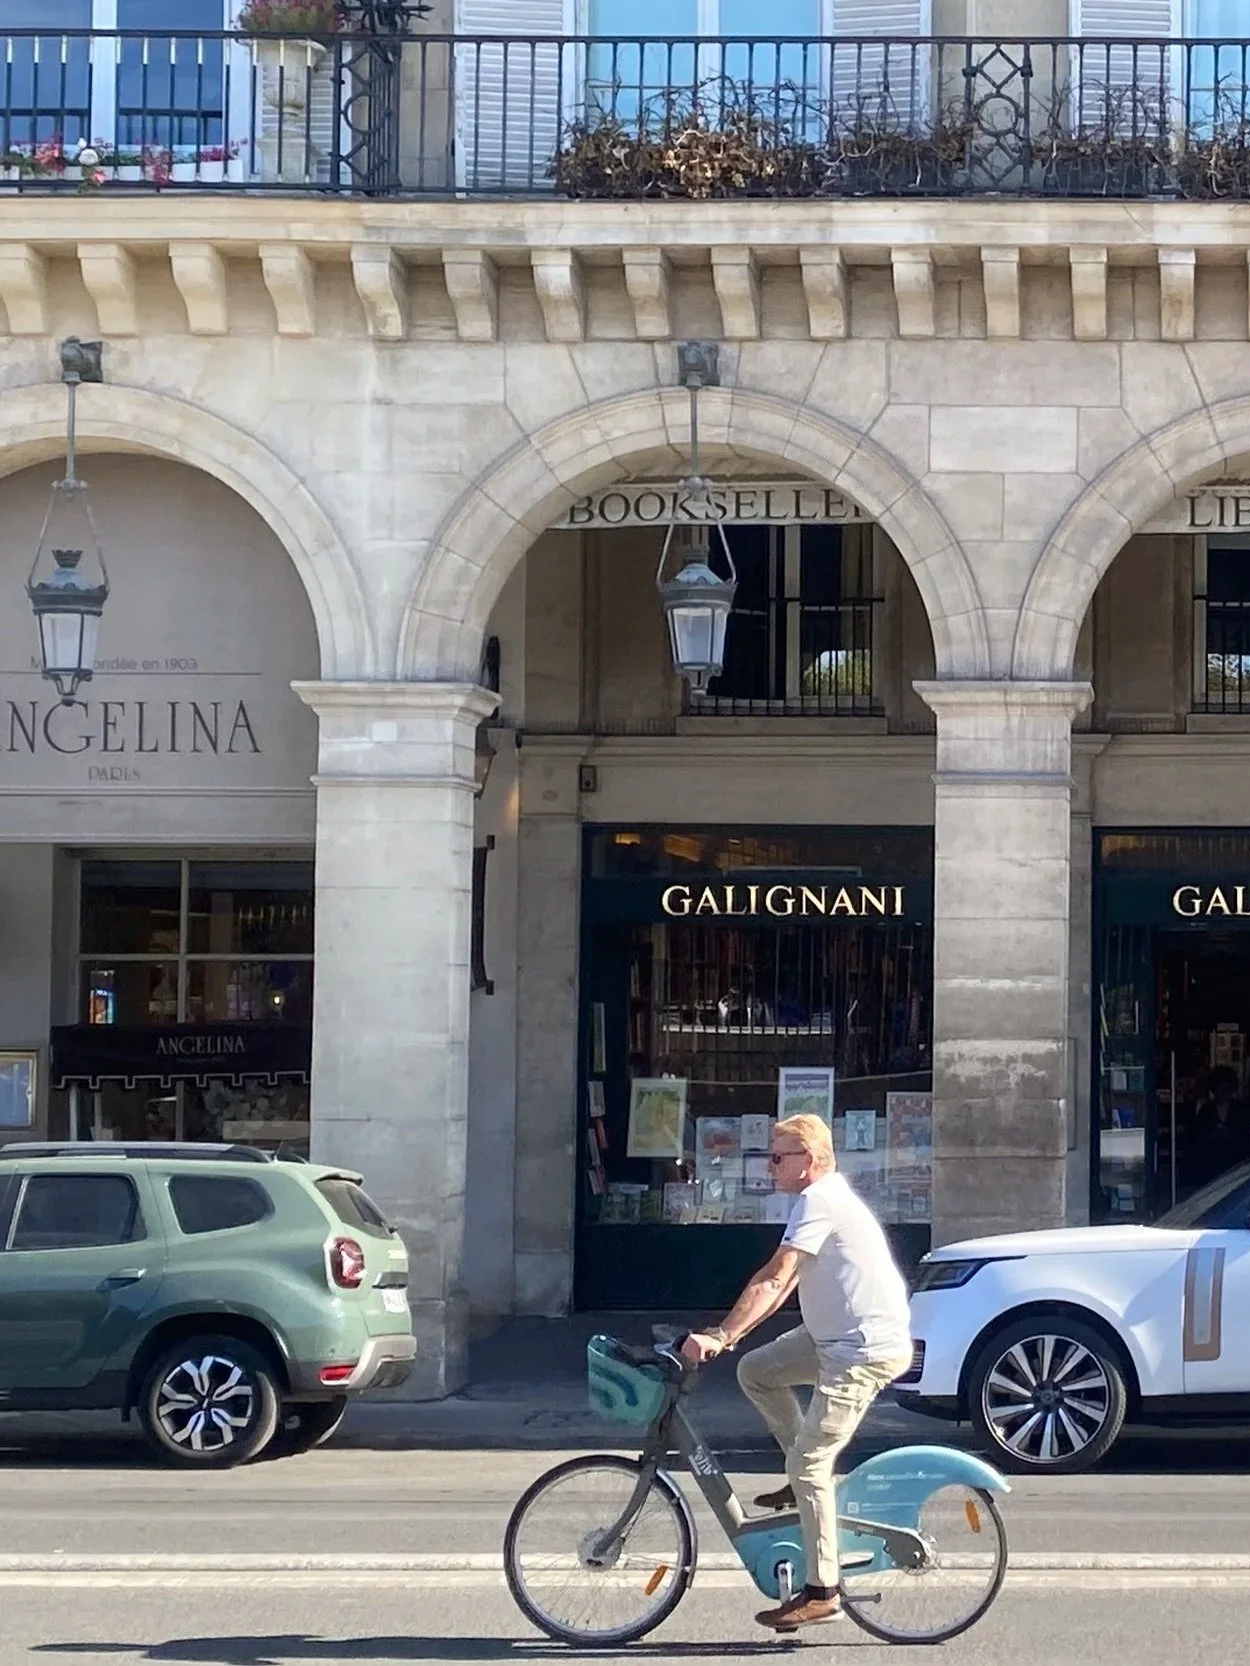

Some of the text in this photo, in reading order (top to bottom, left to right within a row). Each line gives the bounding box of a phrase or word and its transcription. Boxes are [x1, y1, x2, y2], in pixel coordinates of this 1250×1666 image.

[92, 657, 198, 671] ondée en 1903
[0, 699, 262, 755] NGELINA
[88, 765, 141, 782] PARIS
[661, 884, 906, 917] GALIGNANI
[156, 1034, 246, 1055] ANGELINA
